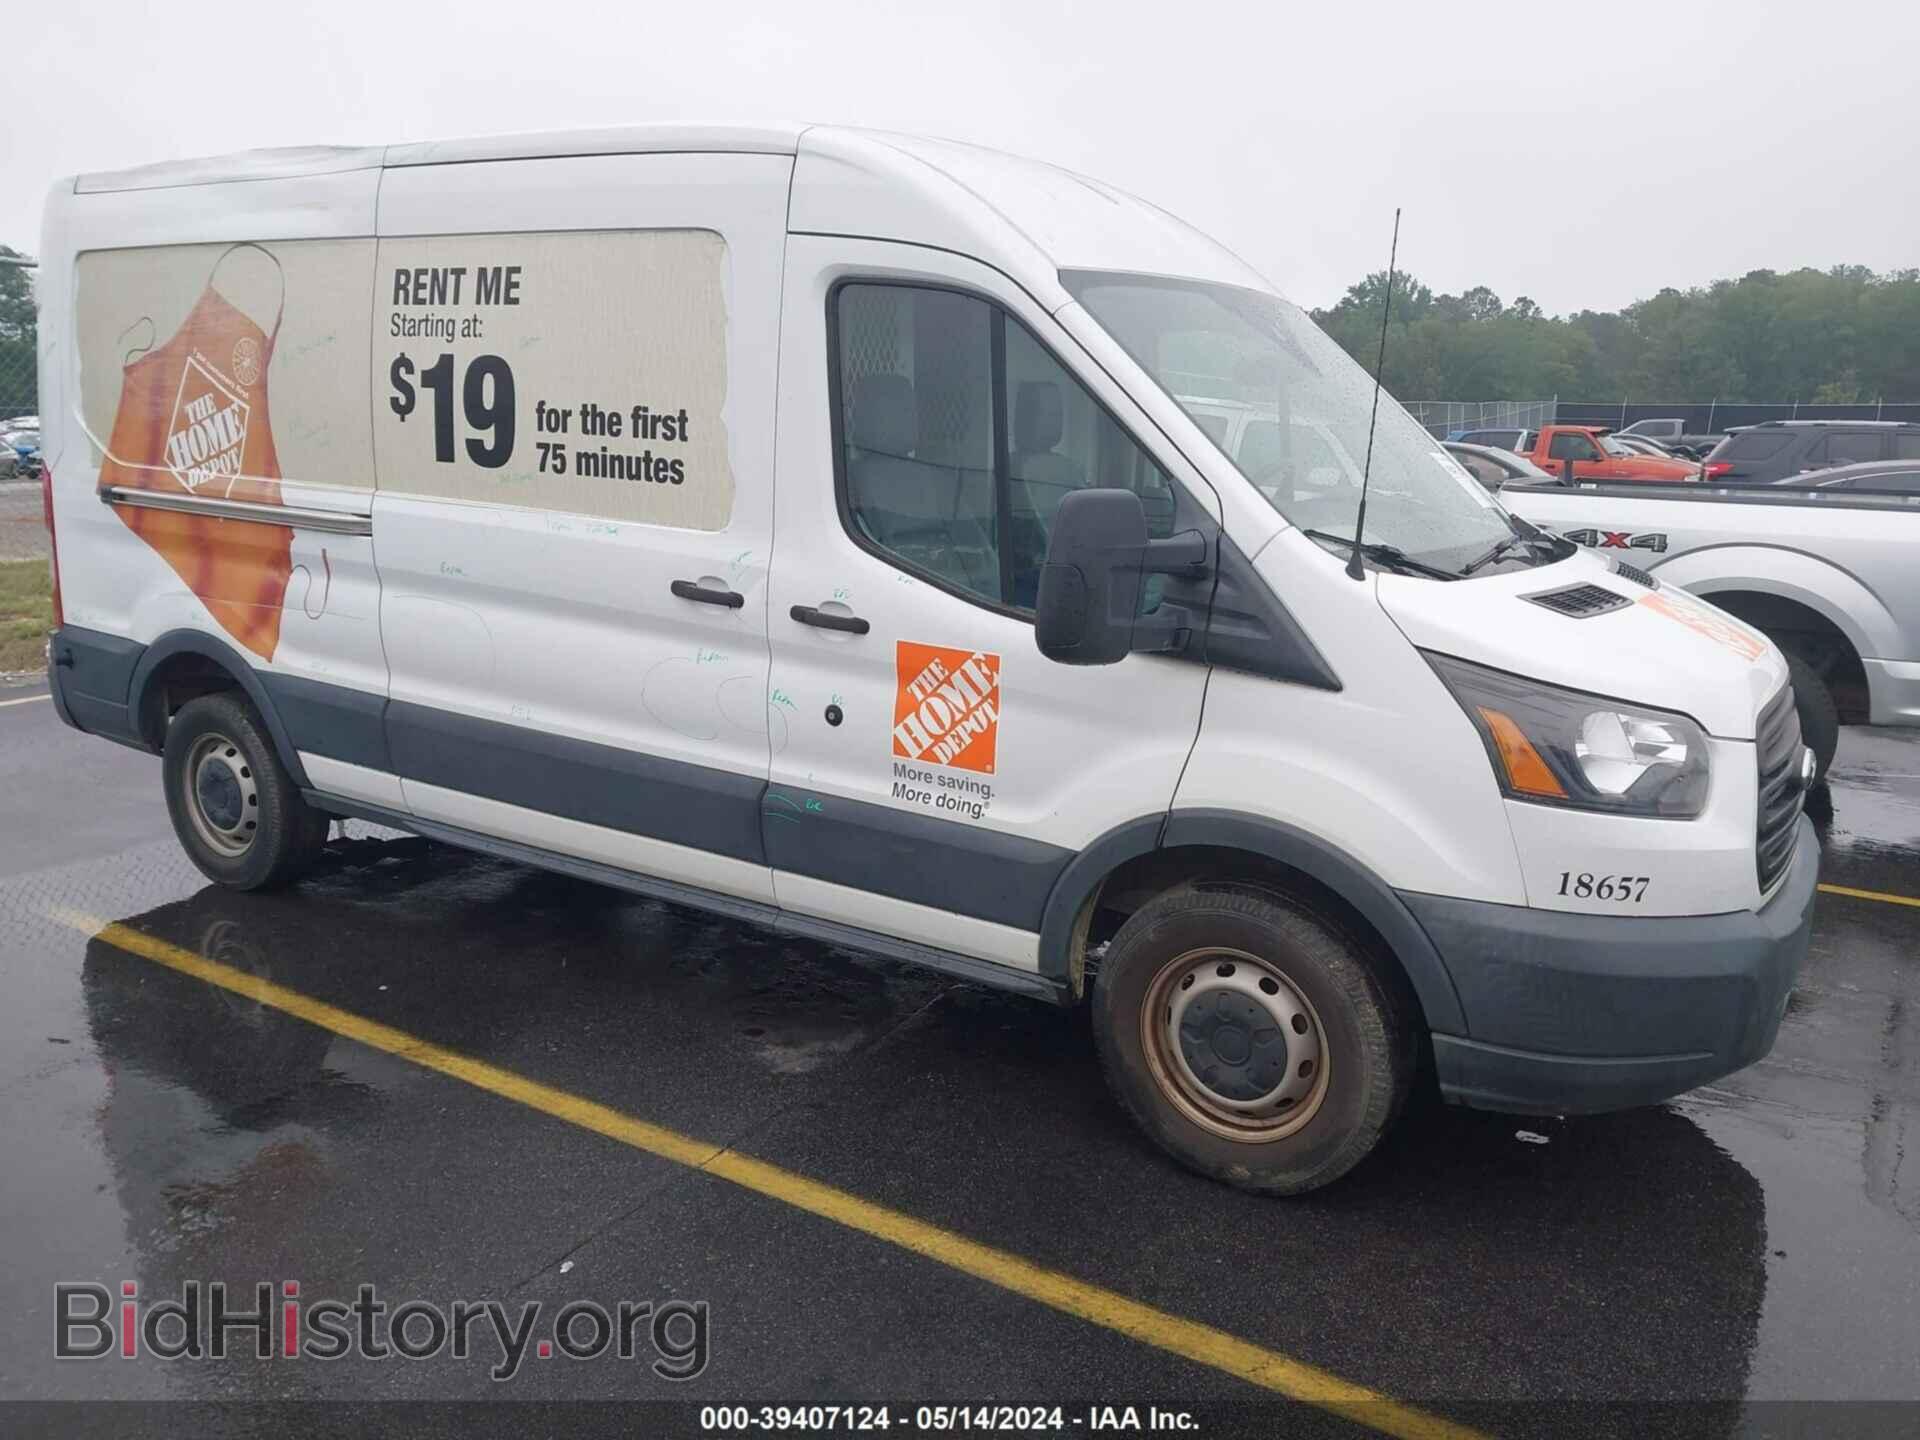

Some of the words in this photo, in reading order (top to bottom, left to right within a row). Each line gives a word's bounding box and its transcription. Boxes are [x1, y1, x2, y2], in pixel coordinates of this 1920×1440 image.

[392, 267, 467, 306] RENT
[475, 266, 522, 306] ME
[390, 312, 456, 343] Starting
[460, 315, 483, 338] at:
[184, 393, 217, 425] THE
[389, 352, 516, 469] $19
[535, 400, 573, 433] for
[579, 403, 623, 437] the
[630, 405, 689, 442] first
[170, 401, 245, 471] HOME
[535, 442, 567, 474] 75
[575, 446, 685, 485] minutes
[906, 657, 950, 702] THE
[893, 652, 1000, 759] HOME
[932, 698, 999, 765] DEPOT
[892, 782, 932, 804] More
[893, 762, 933, 784] More
[937, 775, 995, 799] saving.
[1557, 871, 1650, 902] 18657
